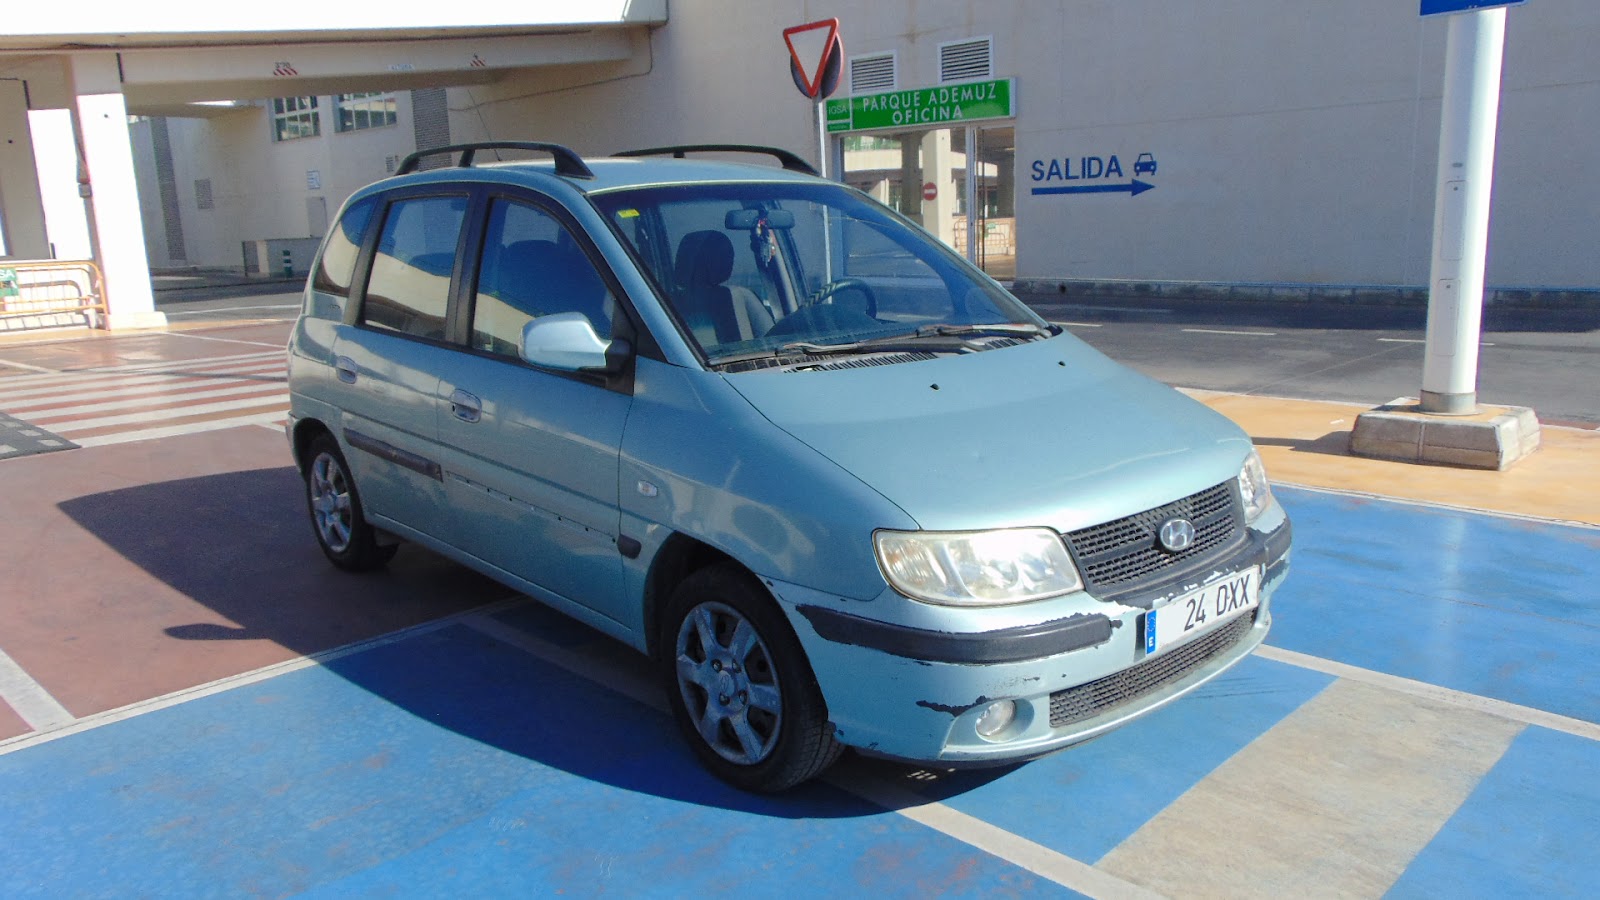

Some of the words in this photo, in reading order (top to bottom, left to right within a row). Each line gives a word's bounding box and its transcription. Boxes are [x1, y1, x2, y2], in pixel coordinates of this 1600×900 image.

[863, 91, 921, 112] PARQUE
[929, 82, 997, 106] ADEMUZ
[892, 104, 963, 124] OFICINA
[1031, 154, 1123, 181] SALIDA
[1184, 593, 1207, 632] 24
[1148, 637, 1154, 648] E
